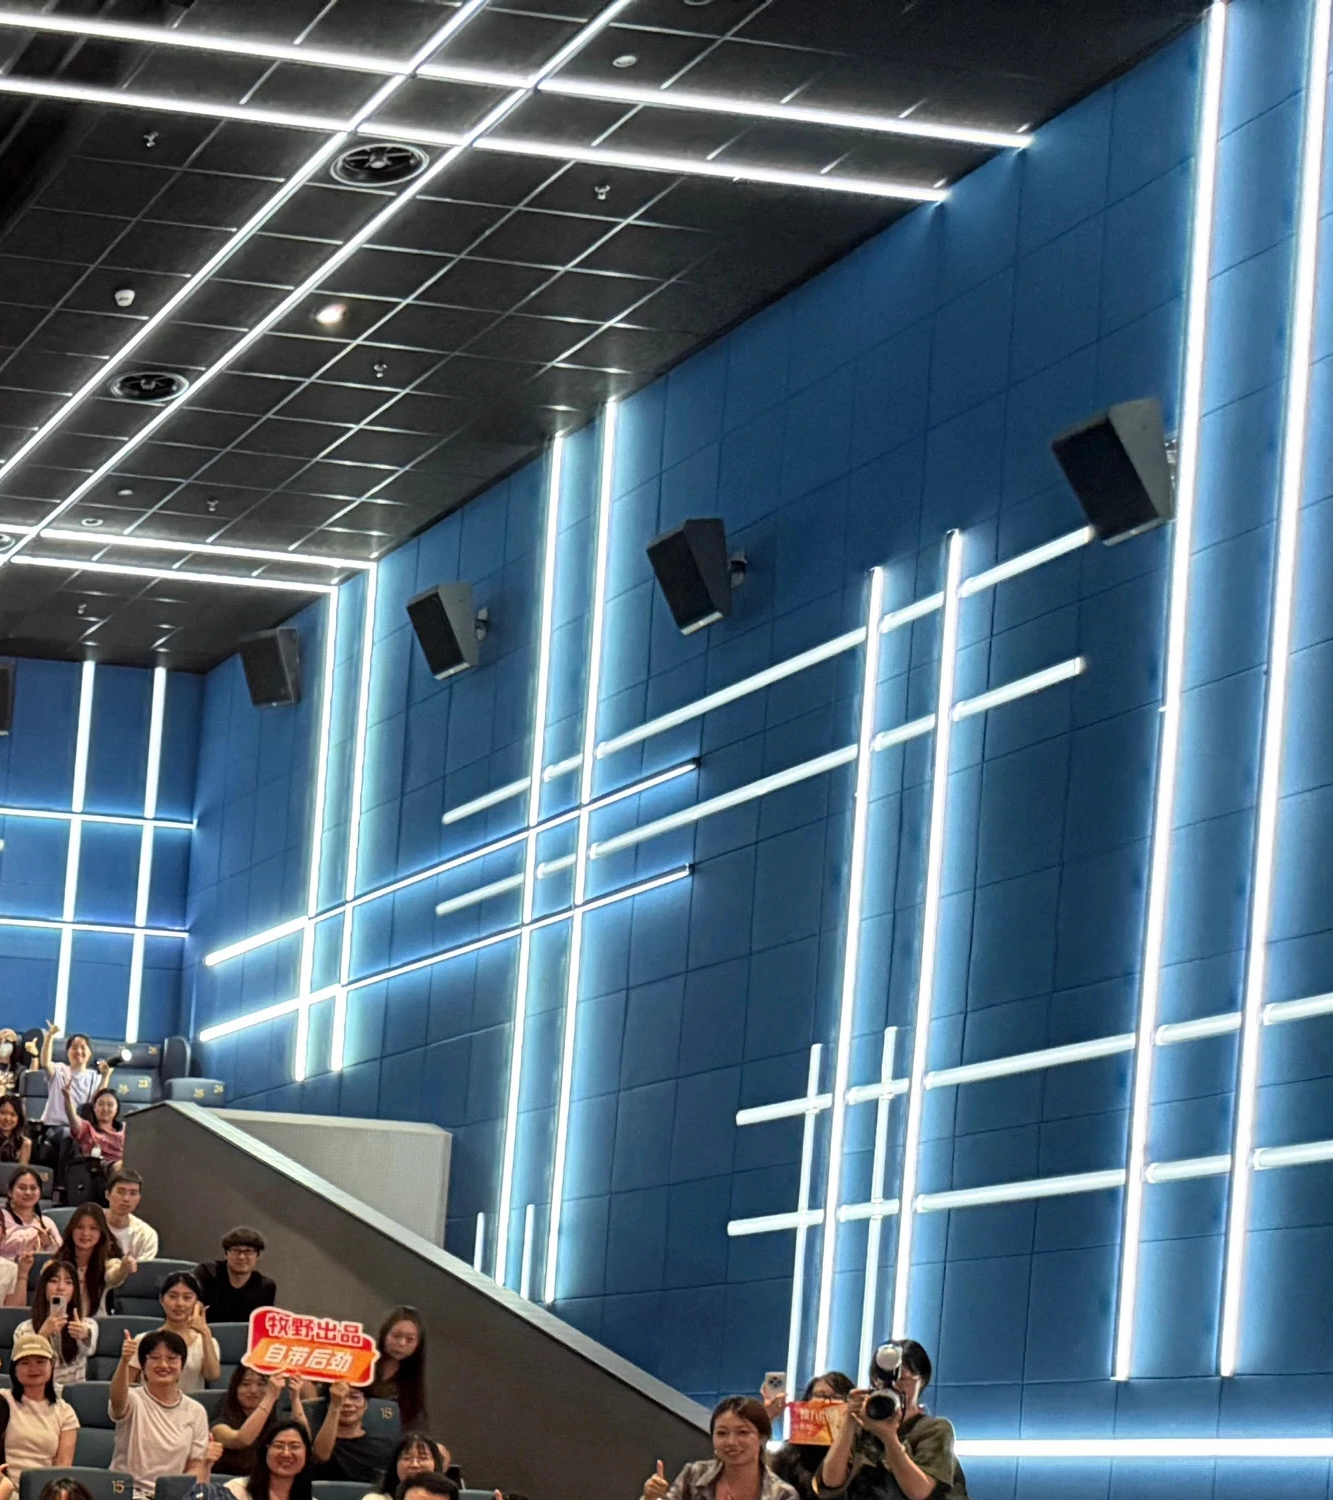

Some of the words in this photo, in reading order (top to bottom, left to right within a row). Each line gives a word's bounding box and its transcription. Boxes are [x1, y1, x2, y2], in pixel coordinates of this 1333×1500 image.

[265, 1312, 364, 1347] 牧野出品
[263, 1343, 354, 1373] 自带后劲
[112, 1480, 124, 1493] 15
